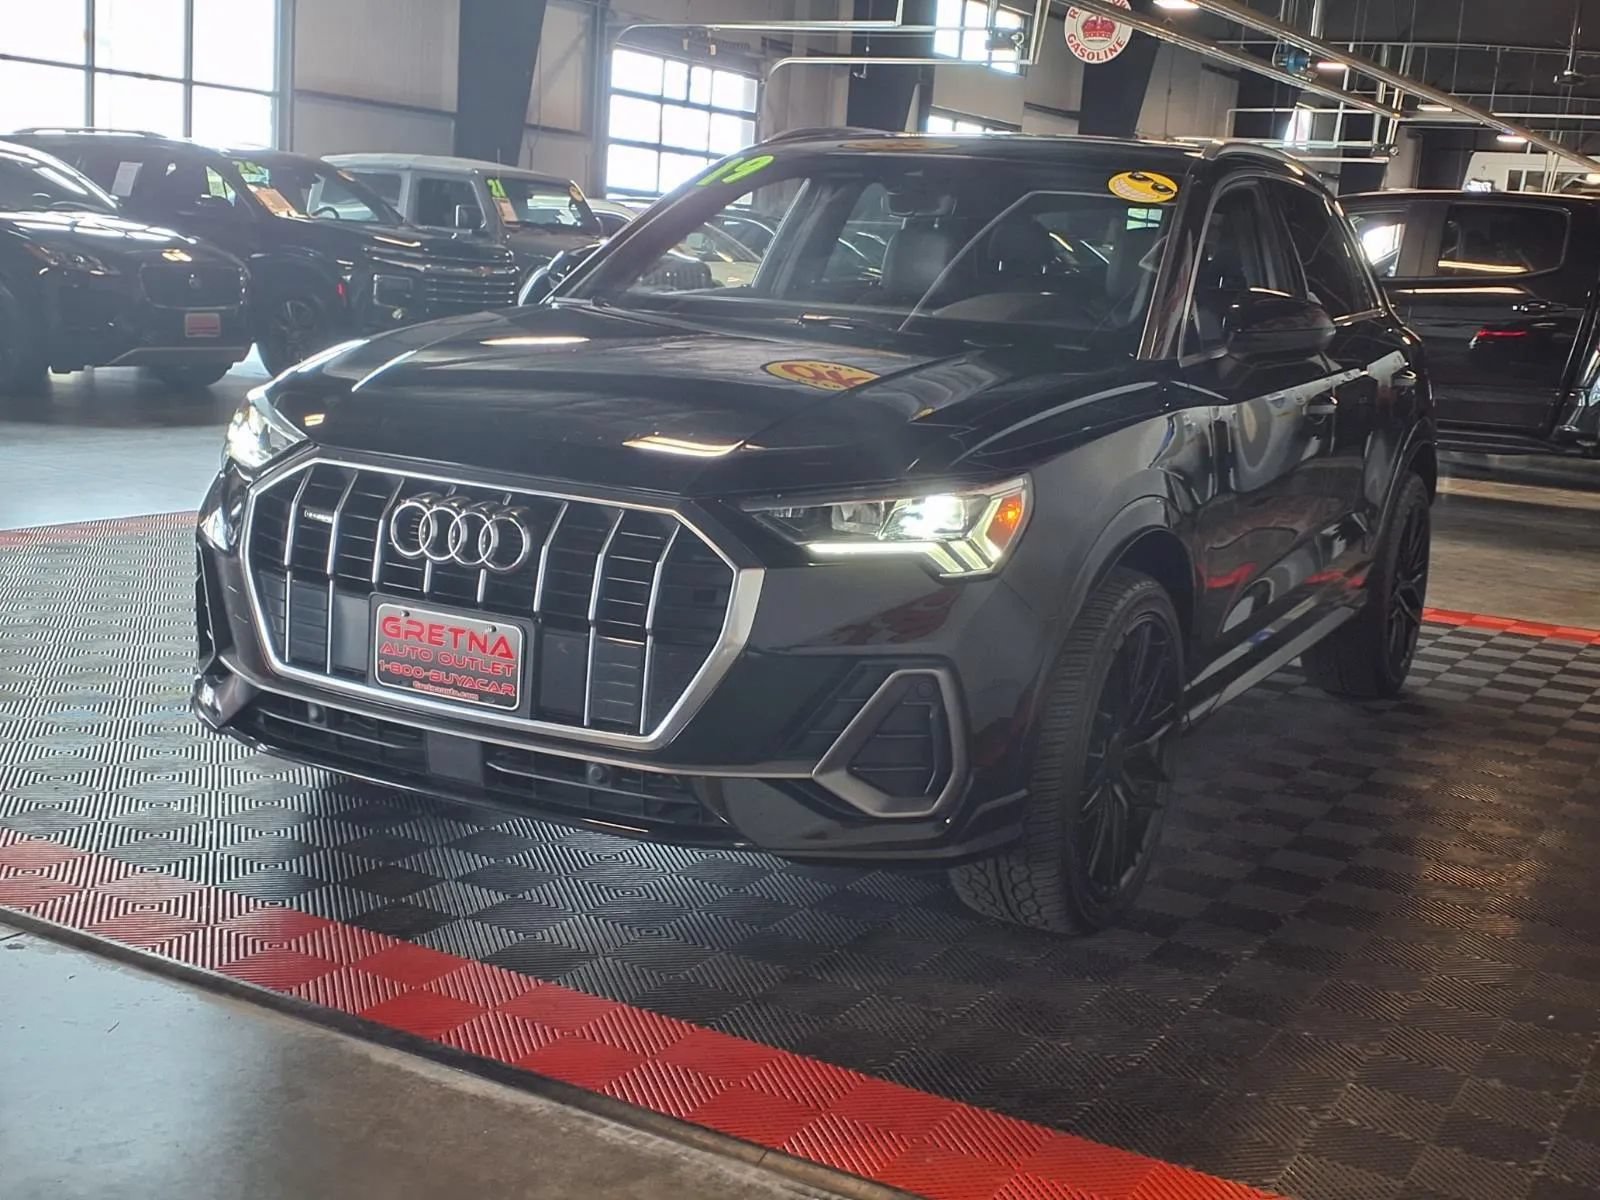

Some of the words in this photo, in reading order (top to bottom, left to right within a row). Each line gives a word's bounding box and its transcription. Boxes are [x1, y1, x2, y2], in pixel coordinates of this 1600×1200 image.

[1067, 33, 1126, 61] GASOLINE
[382, 616, 515, 660] GRETNA
[380, 641, 434, 662] AUTO
[438, 651, 517, 677] OUTLET
[379, 660, 515, 696] 1-800-BUYACAR
